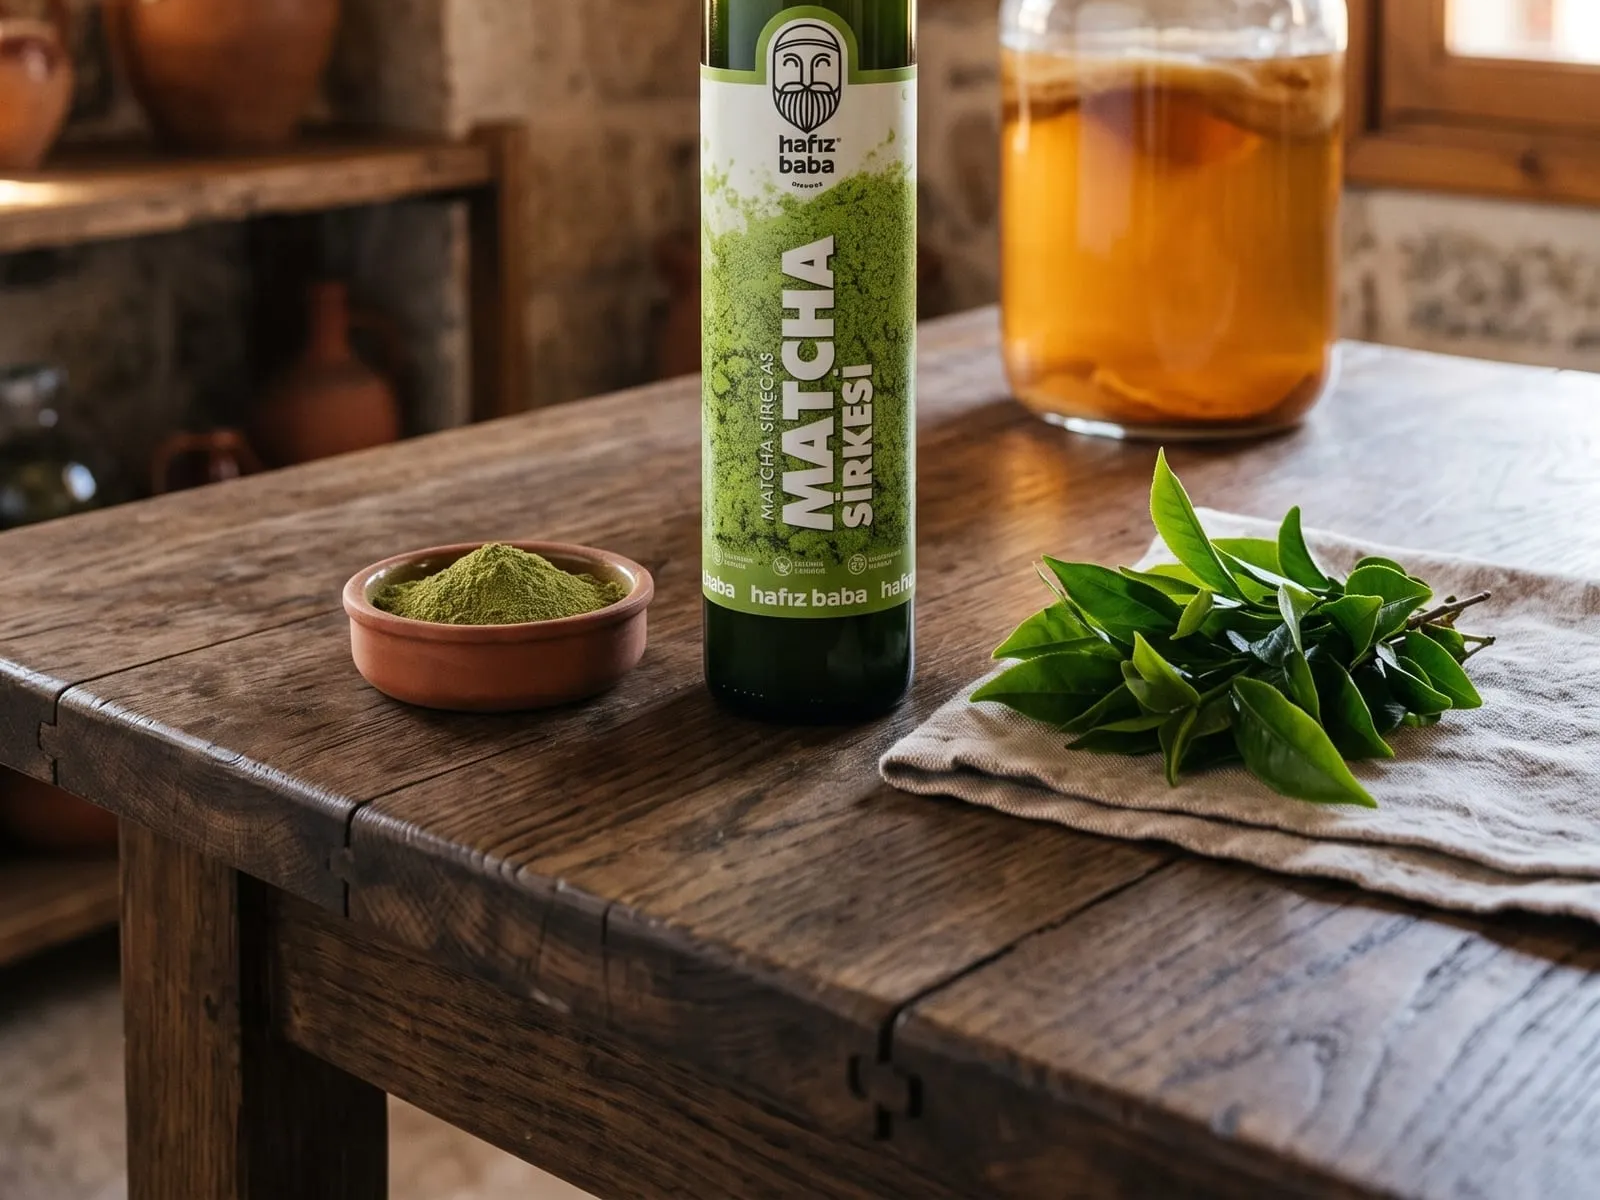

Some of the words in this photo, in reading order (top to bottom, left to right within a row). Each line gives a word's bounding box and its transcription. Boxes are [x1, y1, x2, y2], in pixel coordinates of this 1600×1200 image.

[779, 155, 835, 174] baba
[782, 235, 835, 531] MATCHA
[760, 440, 774, 520] MATCHA
[812, 587, 868, 607] baba
